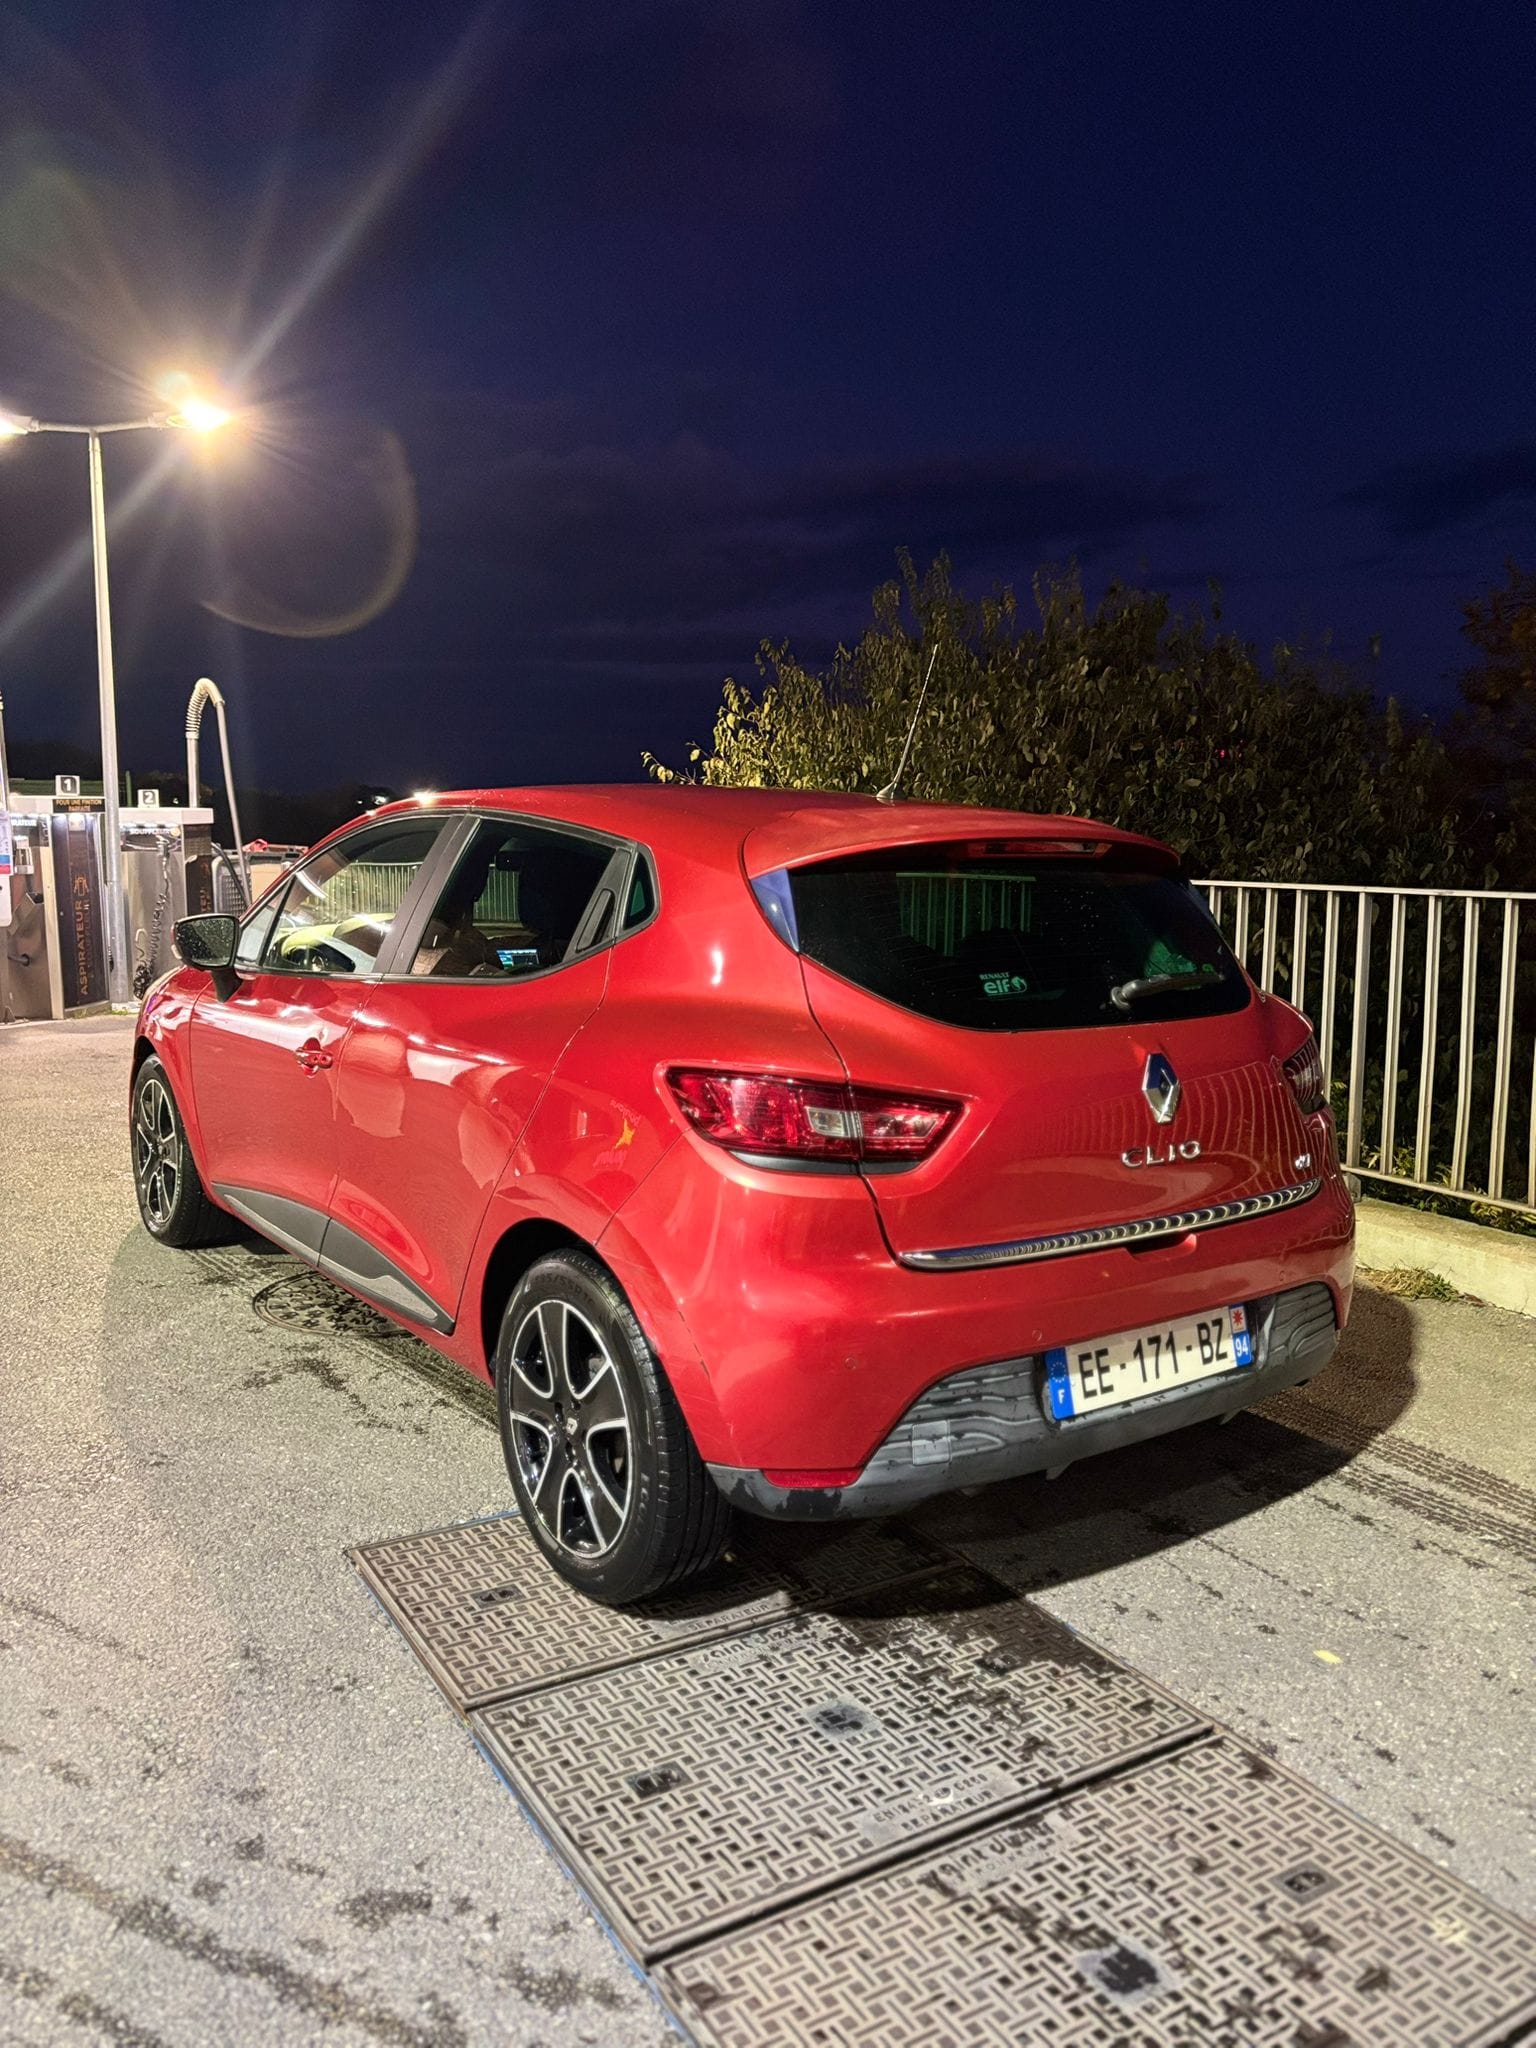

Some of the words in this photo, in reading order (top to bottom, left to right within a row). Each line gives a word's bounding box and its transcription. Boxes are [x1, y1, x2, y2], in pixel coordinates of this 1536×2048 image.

[64, 779, 72, 791] 1
[144, 791, 154, 803] 2
[75, 900, 88, 996] ASPIRATEUR
[983, 979, 1010, 994] elf
[1121, 1140, 1200, 1168] CLIO
[1057, 1388, 1065, 1404] F
[1235, 1335, 1249, 1358] 94
